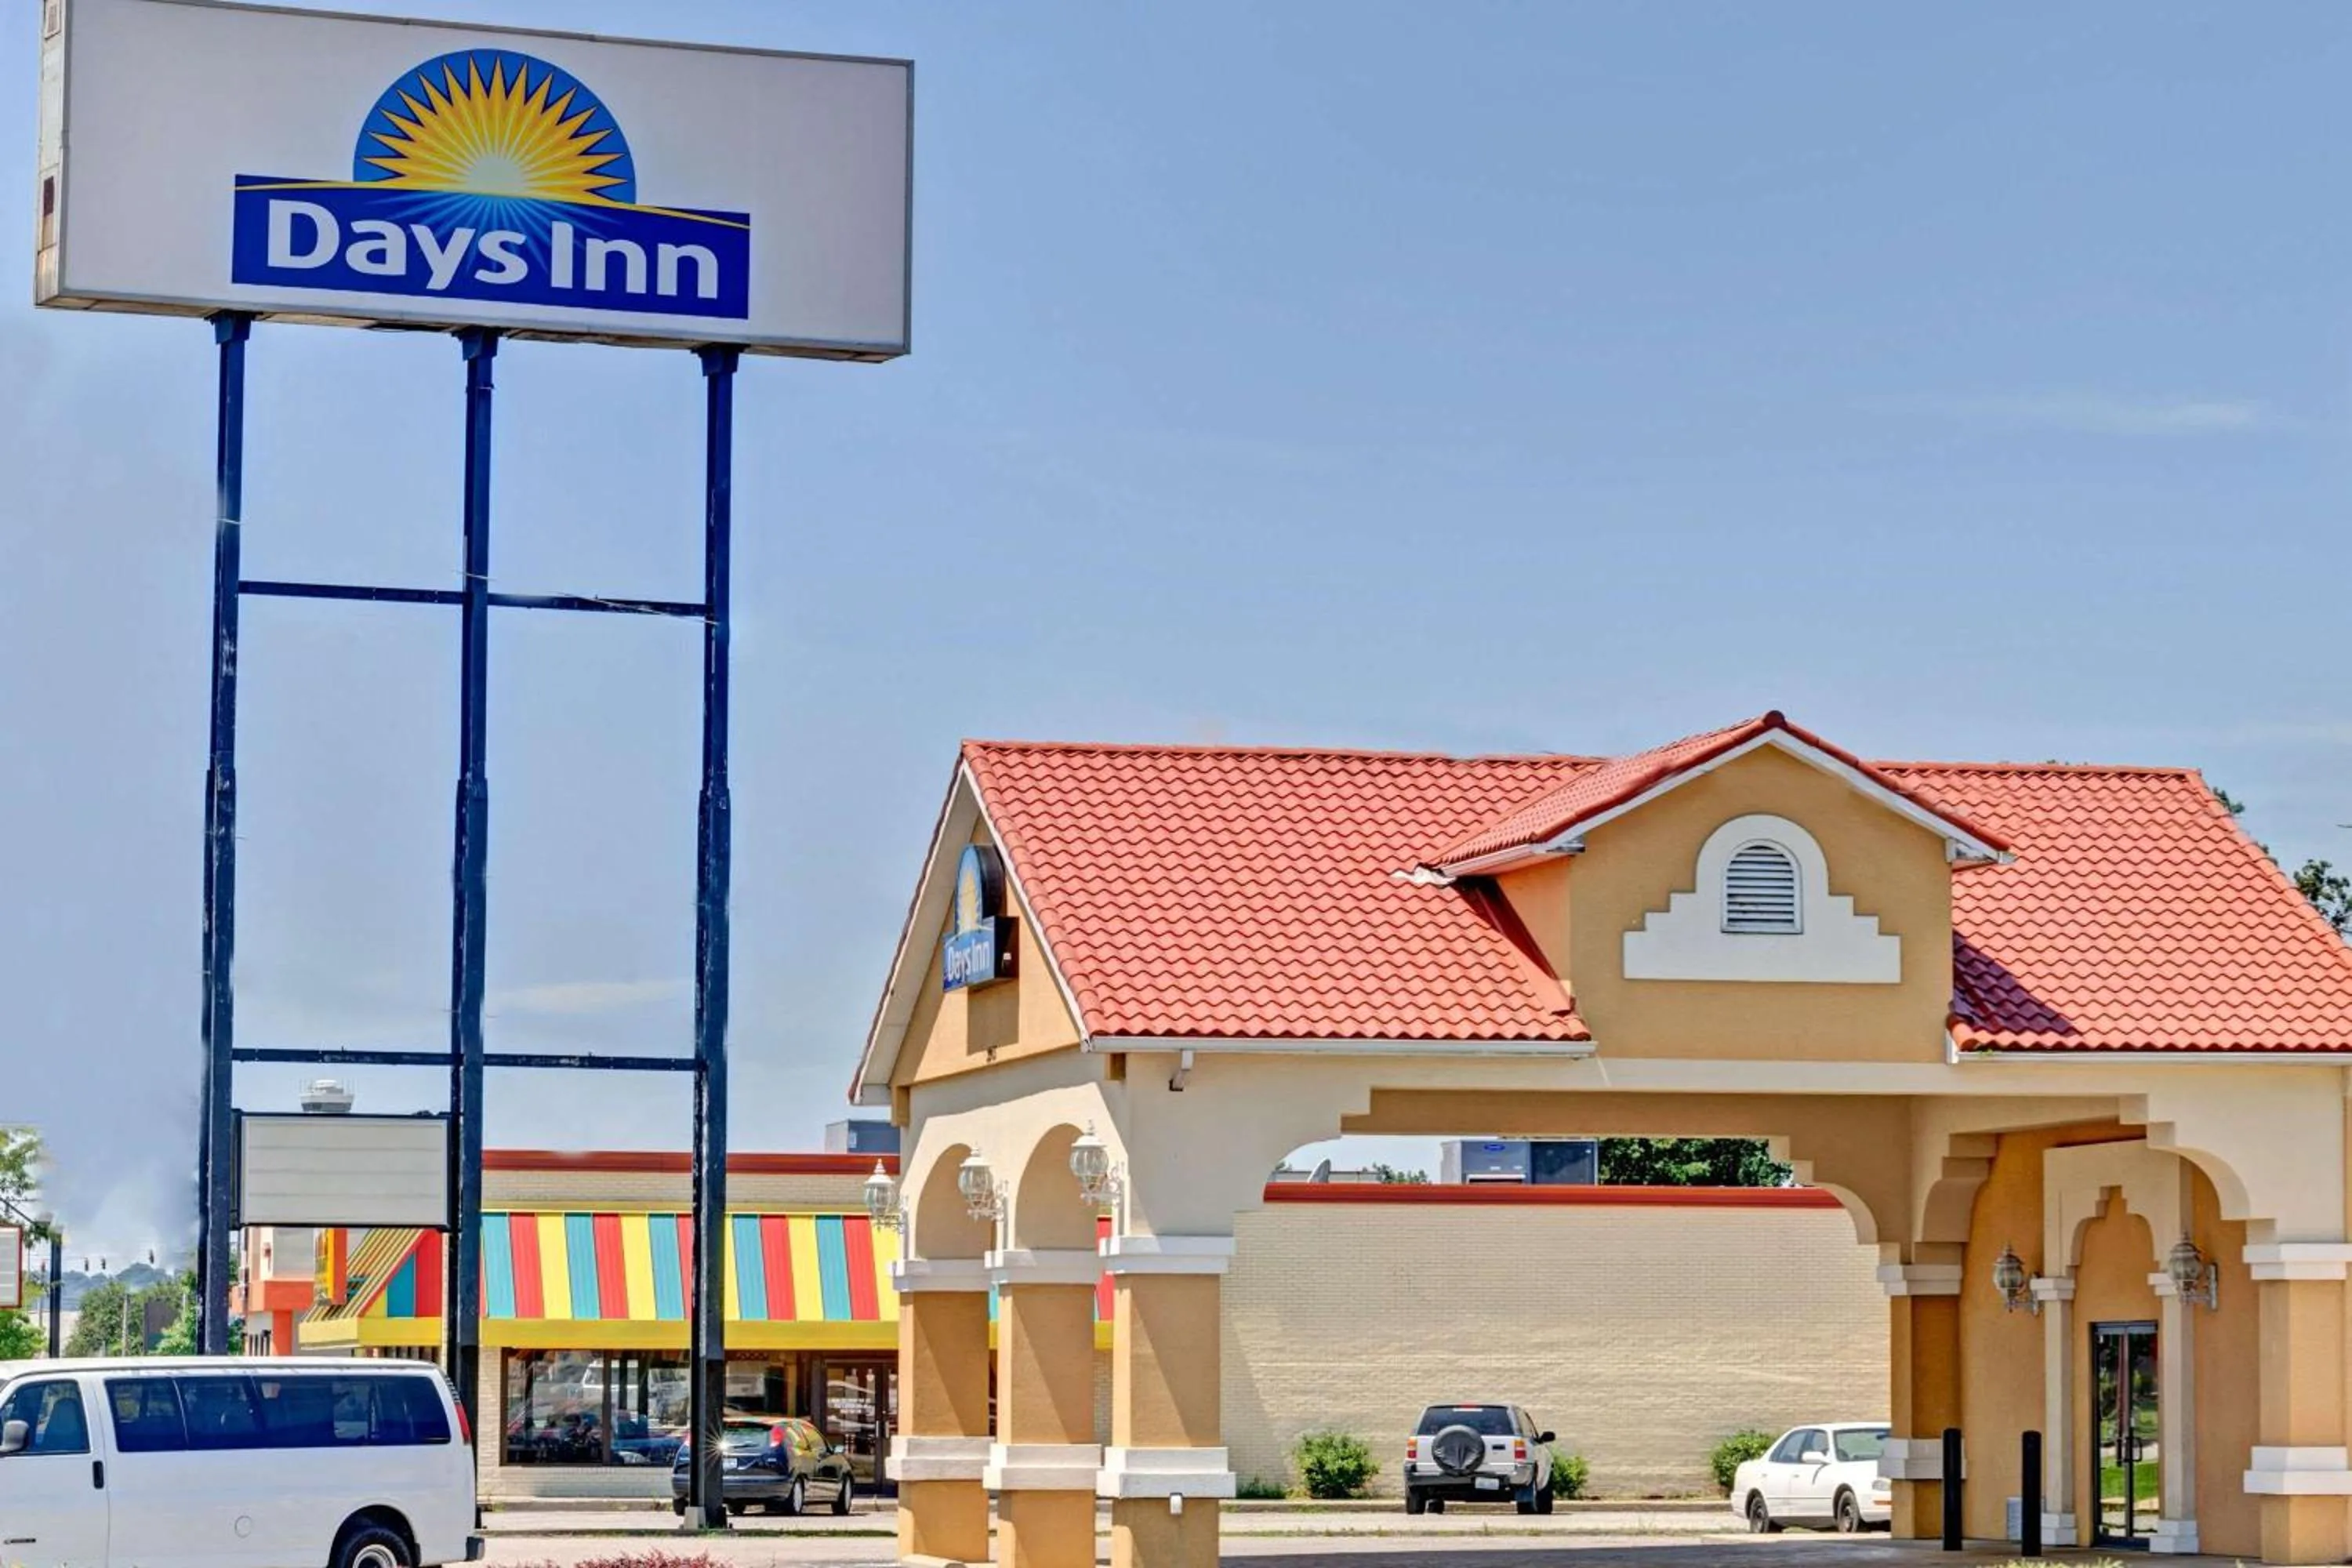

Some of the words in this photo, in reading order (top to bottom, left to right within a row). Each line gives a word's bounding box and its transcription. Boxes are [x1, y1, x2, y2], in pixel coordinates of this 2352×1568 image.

[267, 199, 528, 290] Days
[551, 222, 718, 299] Inn
[948, 946, 971, 983] Days
[972, 938, 990, 972] Inn
